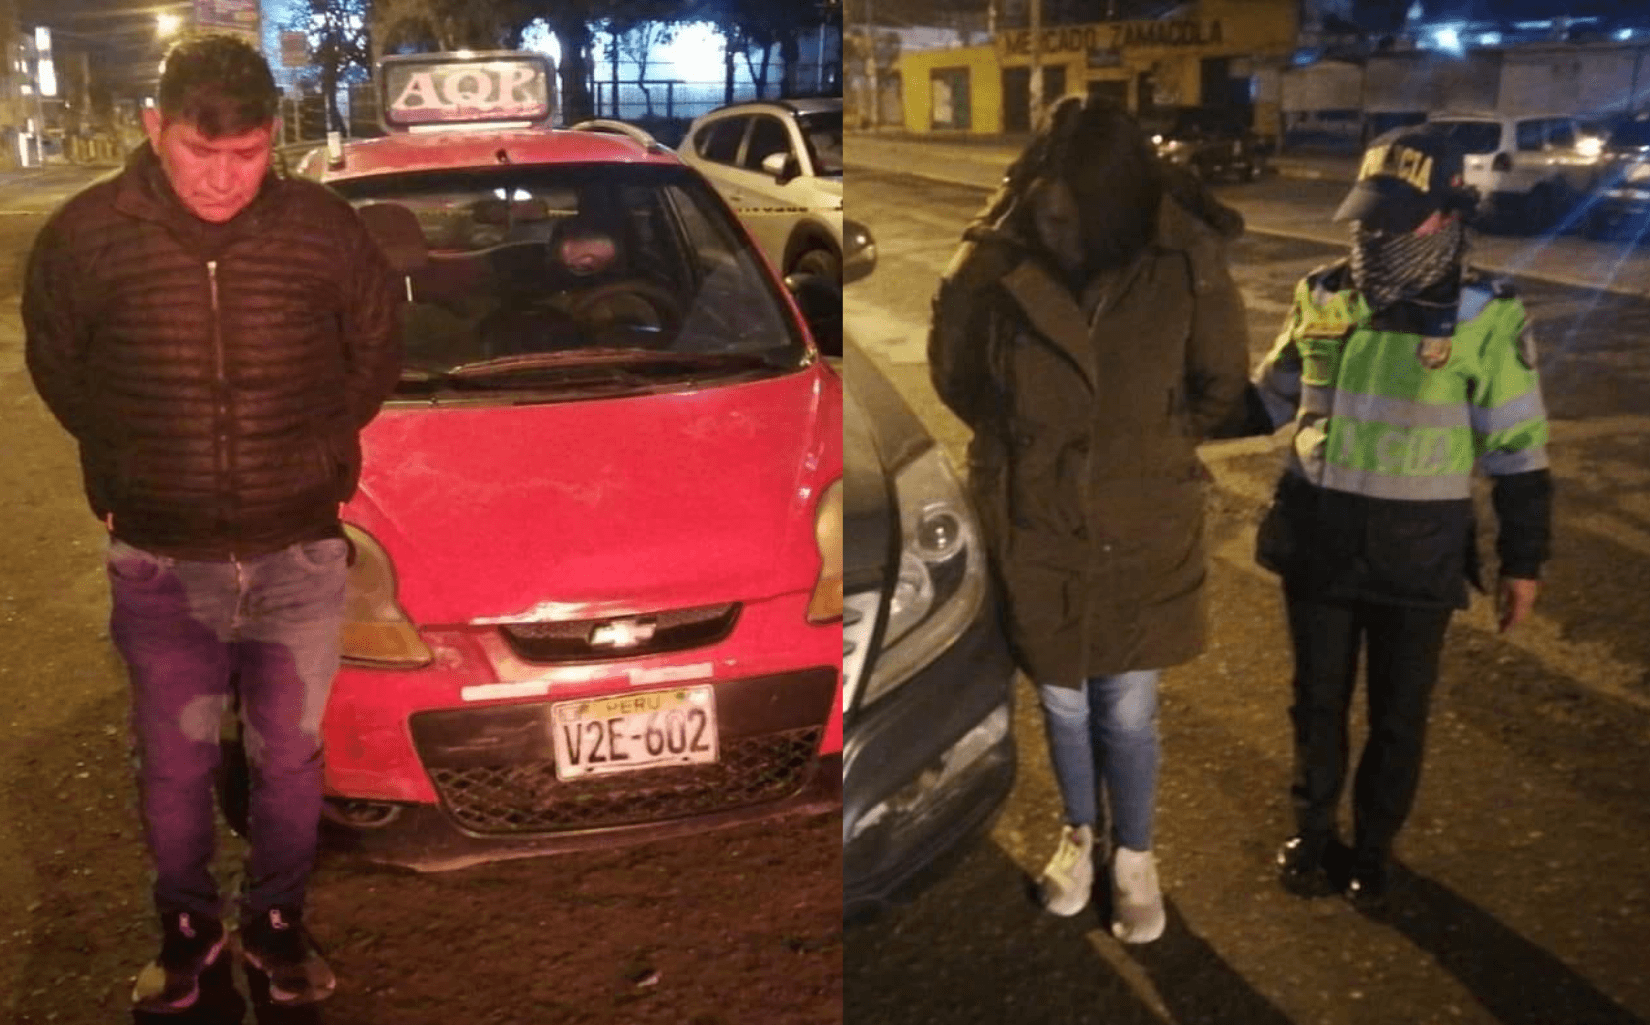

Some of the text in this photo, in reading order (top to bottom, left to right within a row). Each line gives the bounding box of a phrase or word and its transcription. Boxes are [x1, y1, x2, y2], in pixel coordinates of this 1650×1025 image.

[1004, 20, 1223, 53] MECADO ZAMACOLA
[563, 708, 710, 765] V2E-602
